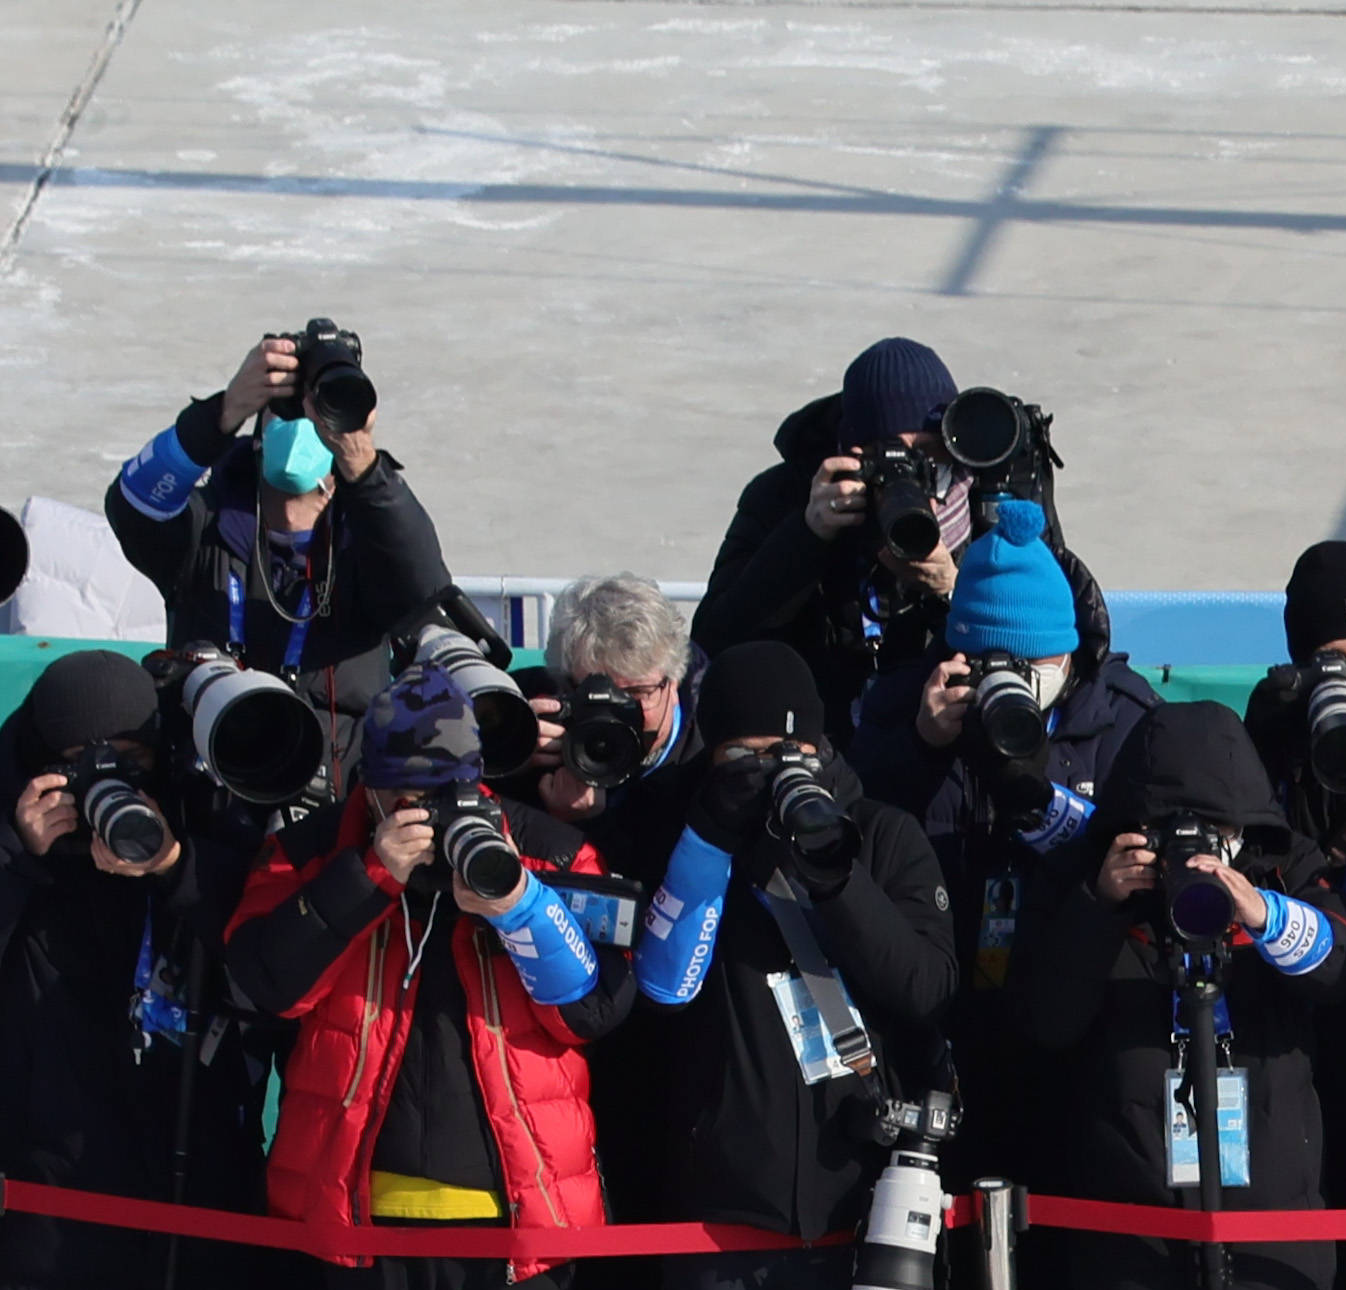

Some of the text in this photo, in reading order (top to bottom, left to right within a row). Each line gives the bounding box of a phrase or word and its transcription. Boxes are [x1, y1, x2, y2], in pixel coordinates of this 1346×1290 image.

[545, 902, 597, 977] PHOTO FOP
[676, 906, 719, 997] PHOTO FOP
[1280, 920, 1301, 949] 046
[1293, 926, 1316, 958] BAS
